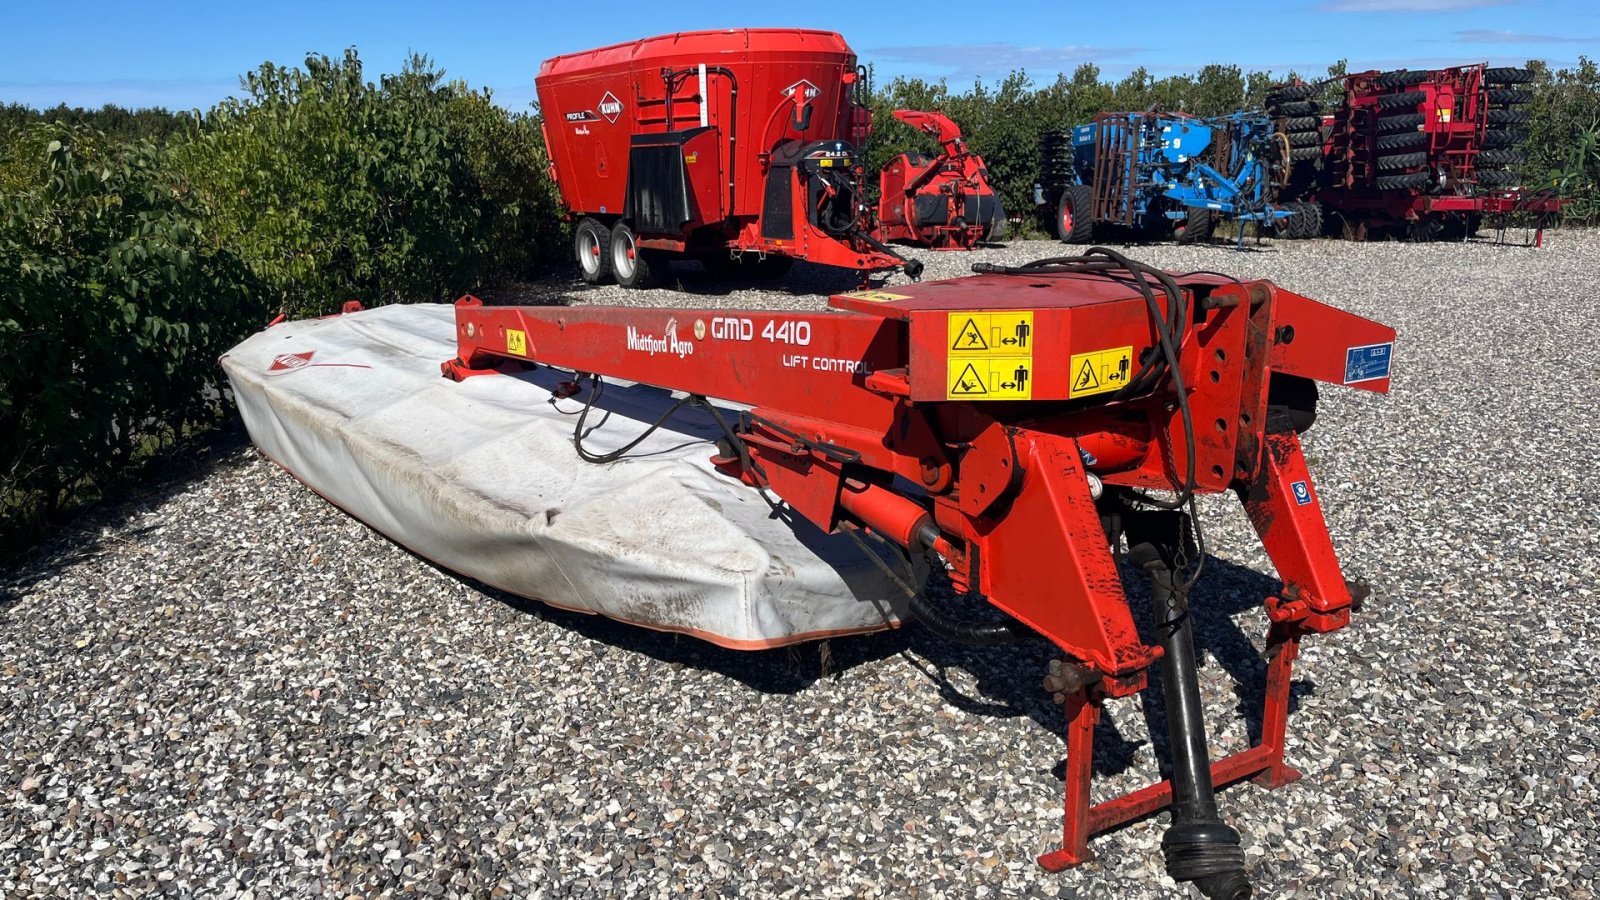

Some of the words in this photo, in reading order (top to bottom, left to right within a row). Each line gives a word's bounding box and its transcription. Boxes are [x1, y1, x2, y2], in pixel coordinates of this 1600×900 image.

[566, 112, 586, 121] PROFILE
[601, 102, 621, 114] KUHN
[627, 326, 667, 356] Midtfjord
[669, 322, 693, 359] Agro
[711, 317, 754, 341] GMD
[761, 320, 811, 346] 4410
[782, 354, 808, 369] LIFT
[812, 355, 872, 376] CONTROL
